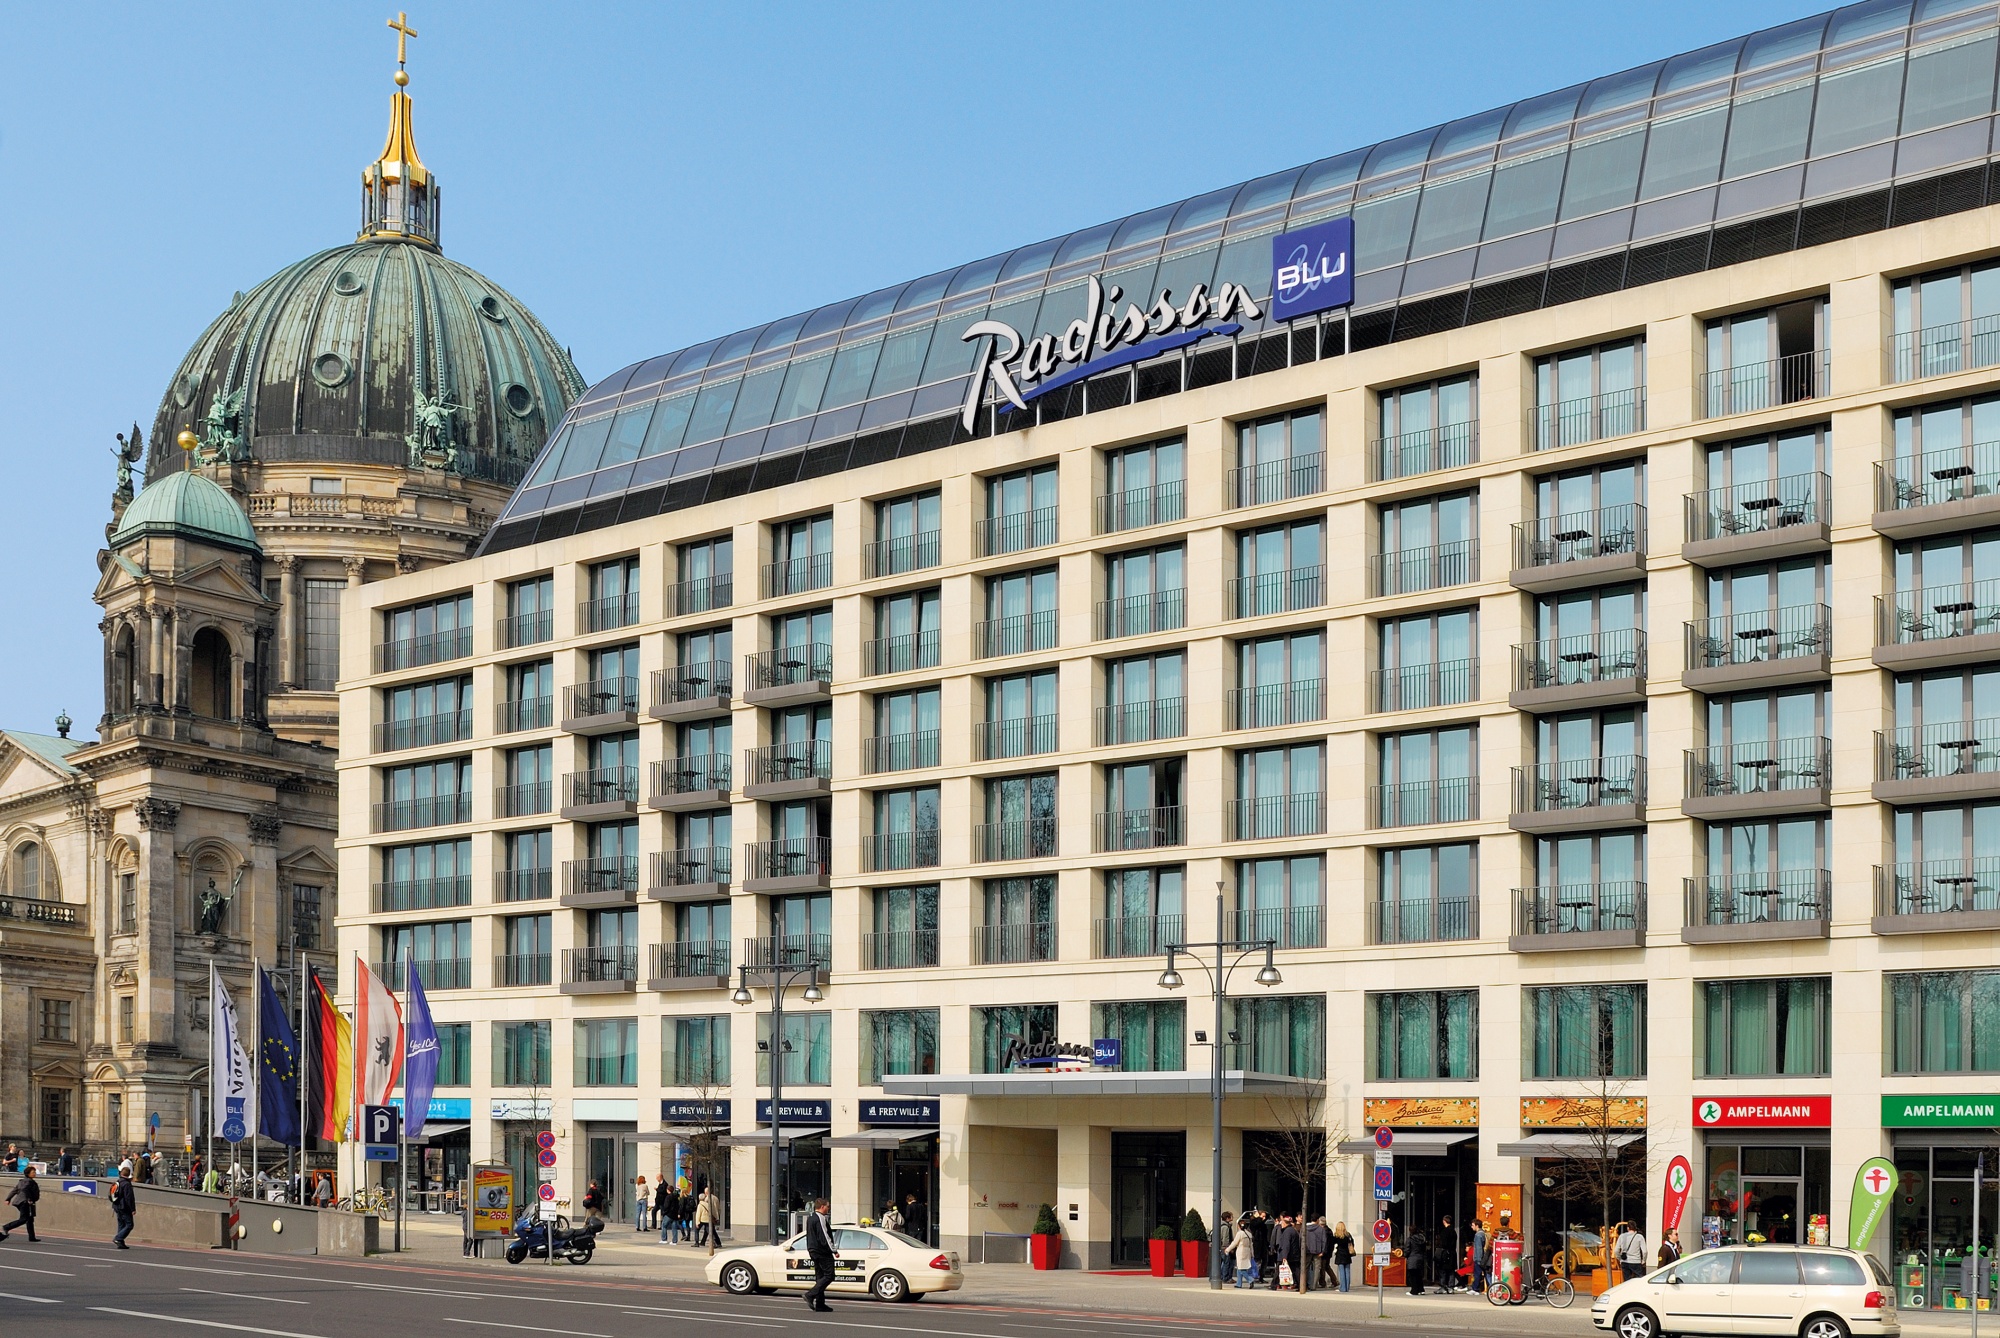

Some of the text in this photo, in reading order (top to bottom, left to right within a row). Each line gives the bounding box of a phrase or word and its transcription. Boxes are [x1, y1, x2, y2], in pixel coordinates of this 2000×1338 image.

[1276, 251, 1347, 292] BLU
[961, 273, 1264, 436] Radisson
[1001, 1030, 1095, 1068] Radisson
[1095, 1048, 1116, 1057] BLU
[678, 1106, 696, 1115] FREY
[778, 1107, 813, 1116] REY WILLE
[878, 1107, 920, 1116] FREY WILLE
[1727, 1105, 1811, 1118] AMPELMANN
[1903, 1104, 1995, 1117] AMPELMANN
[374, 1114, 390, 1142] P
[1375, 1188, 1391, 1197] TAXI
[1855, 1198, 1882, 1247] ampelmann.de
